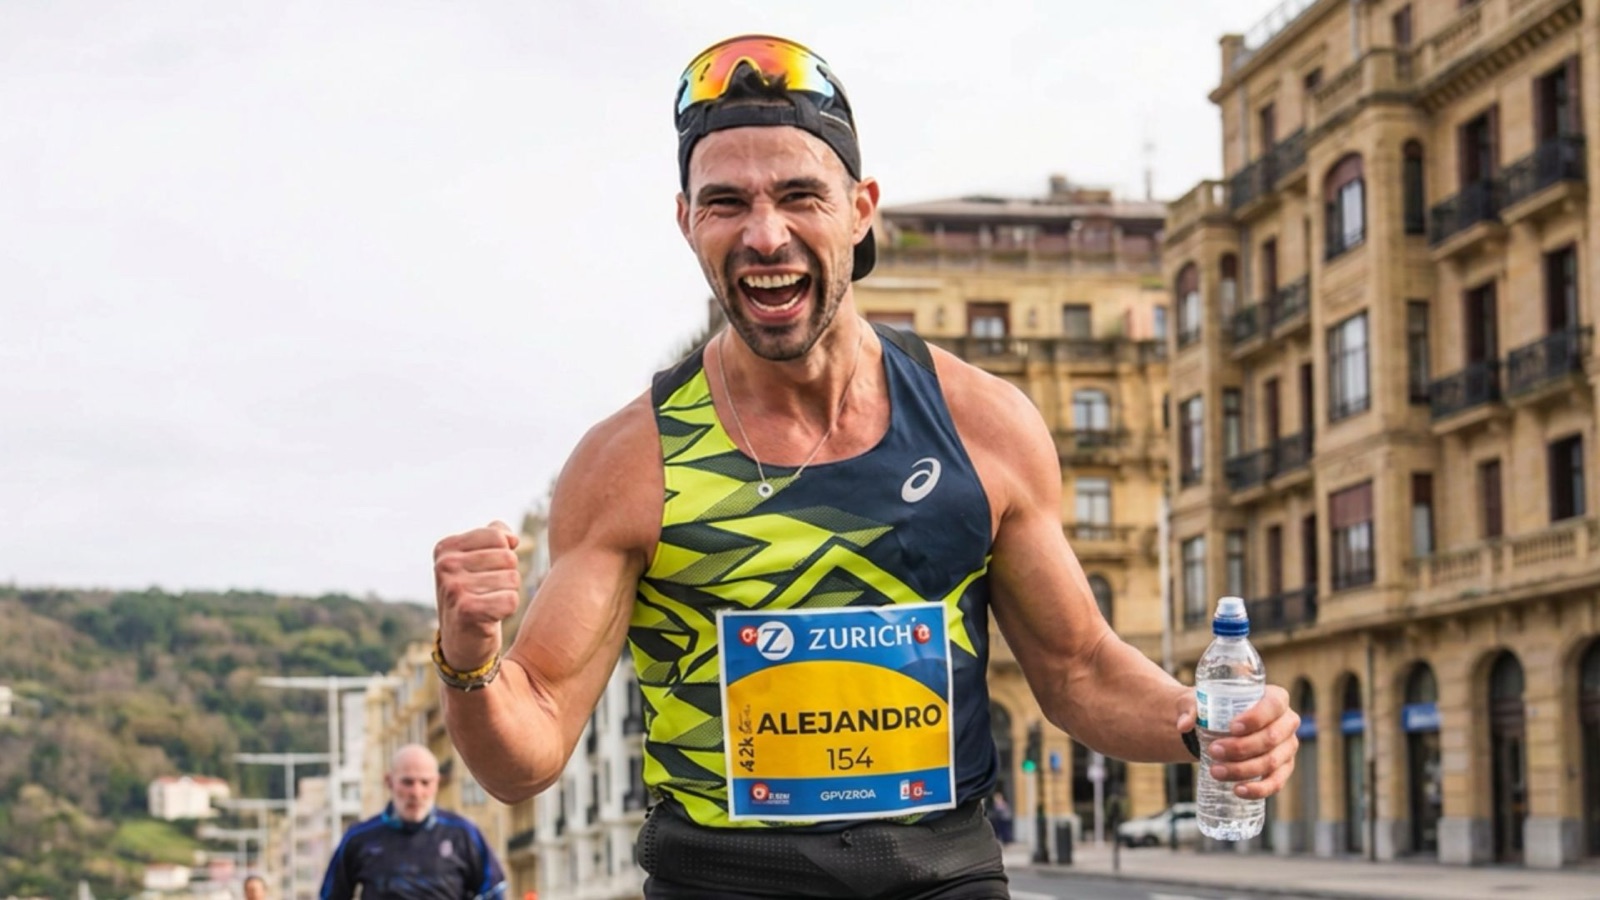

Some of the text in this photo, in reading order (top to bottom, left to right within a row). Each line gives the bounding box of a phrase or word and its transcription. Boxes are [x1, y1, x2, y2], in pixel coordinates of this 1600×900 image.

[808, 624, 912, 650] ZURICH
[756, 703, 942, 735] ALEJANDRO
[826, 746, 874, 771] 154
[820, 788, 876, 801] GPVZROA
